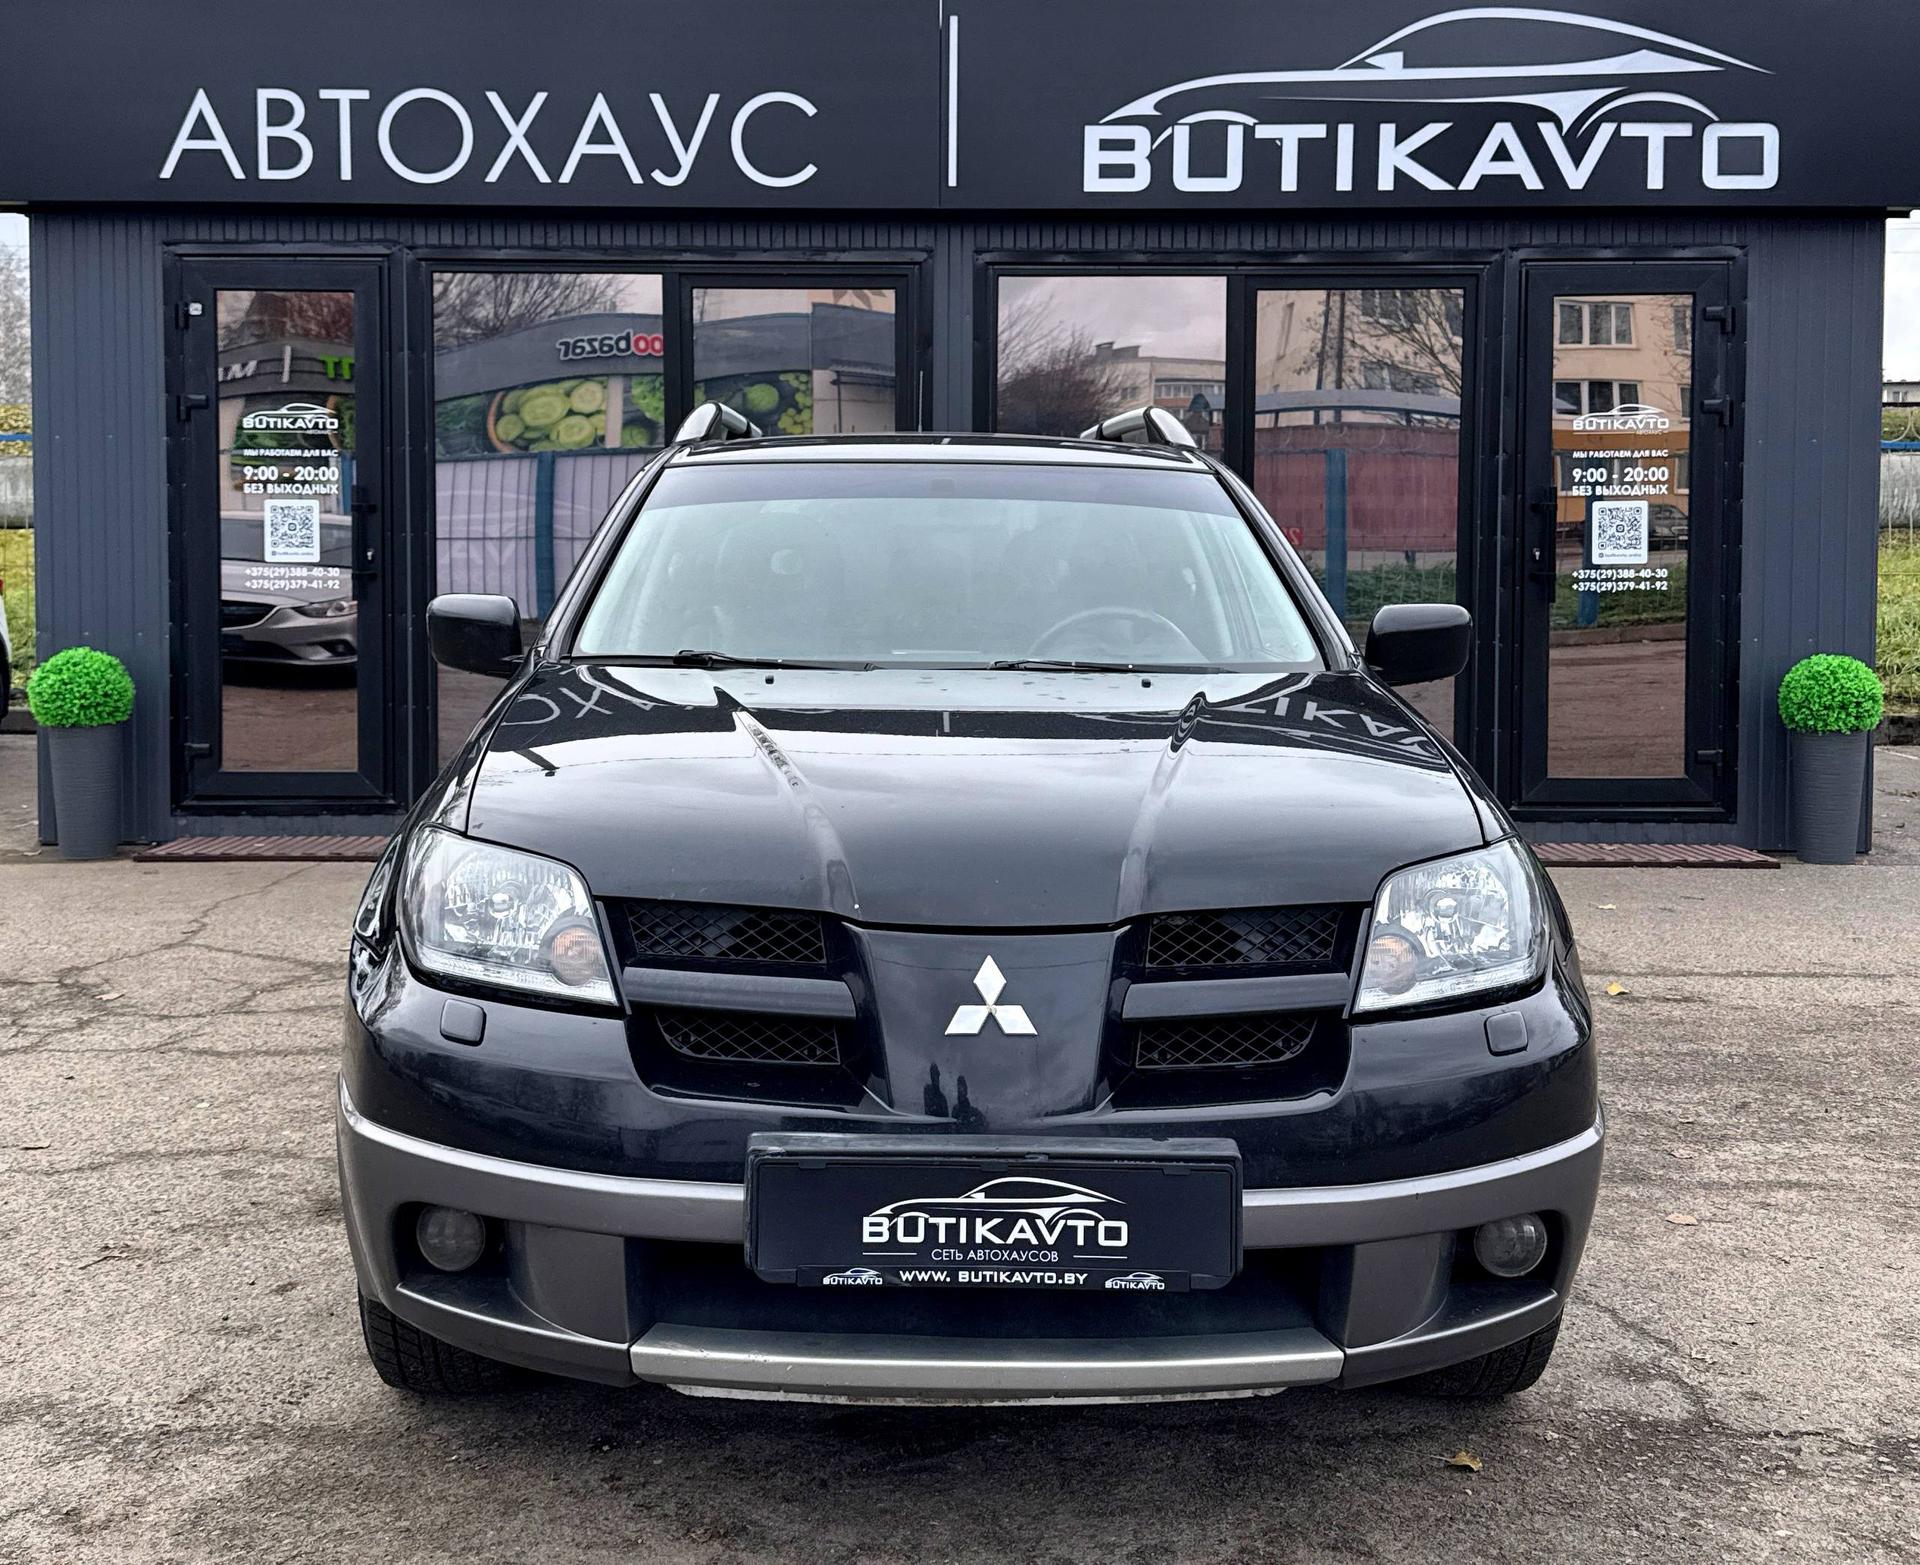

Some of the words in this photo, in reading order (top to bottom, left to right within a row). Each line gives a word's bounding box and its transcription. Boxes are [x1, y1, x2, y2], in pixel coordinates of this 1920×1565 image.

[159, 87, 818, 189] АВТОХАУС
[1082, 121, 1780, 194] BUTIKAVTO
[242, 417, 339, 429] BUTIKAVTO
[1572, 418, 1669, 431] BUTIKAVTO
[243, 448, 258, 457] МЫ
[260, 448, 301, 457] РАБОТАЕМ
[303, 449, 320, 457] ДЛЯ
[1572, 450, 1587, 459] МЫ
[1589, 450, 1631, 458] РАБОТАЕМ
[1633, 450, 1650, 458] ДЛЯ
[1651, 449, 1669, 457] ВАС
[243, 466, 278, 480] 9:00
[294, 466, 339, 480] 20:00
[1572, 467, 1607, 482] 9:00
[1623, 466, 1669, 482] 20:00
[243, 483, 264, 494] БЕЗ
[266, 483, 339, 495] ВЫХОДНЫХ
[1572, 485, 1592, 496] БЕЗ
[1595, 484, 1668, 496] ВЫХОДНЫХ
[244, 567, 340, 578] +375(29)388-40-30
[1572, 568, 1668, 581] +375(29)388-40-30
[244, 579, 340, 590] +375(29)379-41-92
[1572, 581, 1668, 593] +375(29)379-41-92
[862, 1216, 1128, 1247] BUTIKAVTO
[931, 1249, 963, 1261] СЕТЬ
[967, 1249, 1059, 1262] АВТОХАУСОВ
[822, 1277, 883, 1285] BUTIKAVTO
[899, 1270, 951, 1282] WWW.
[958, 1270, 1088, 1285] BUTIKAVTO.BY
[1105, 1280, 1165, 1290] BUTIKAVTO
